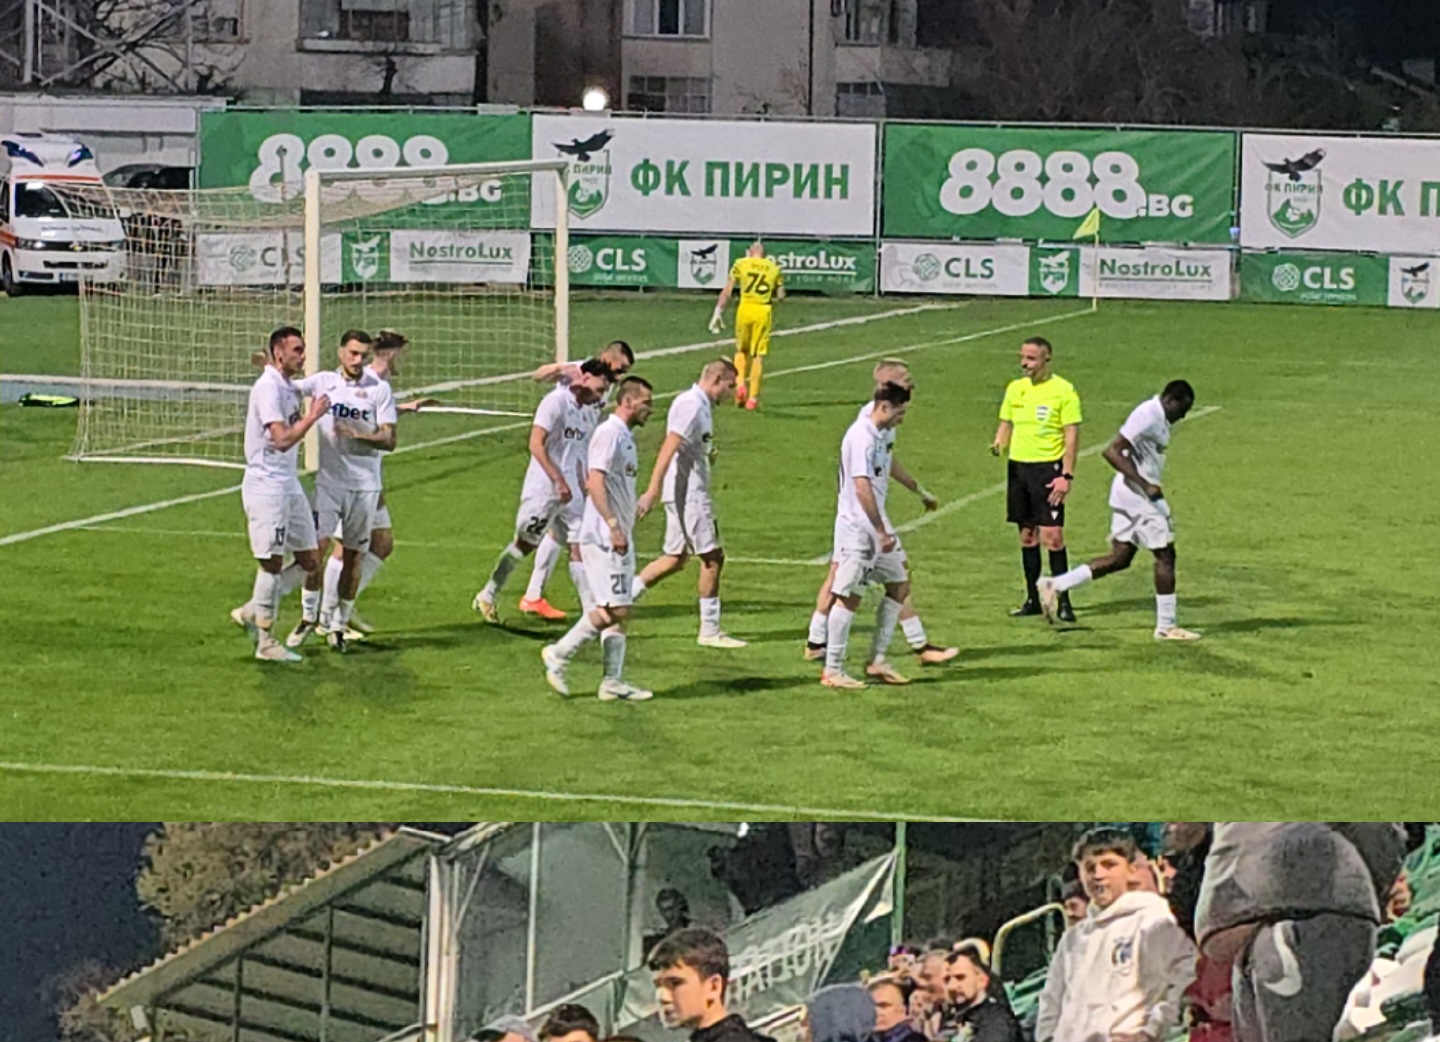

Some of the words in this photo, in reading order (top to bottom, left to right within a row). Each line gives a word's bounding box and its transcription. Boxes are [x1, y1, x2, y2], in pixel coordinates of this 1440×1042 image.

[630, 158, 692, 197] ФК
[704, 161, 850, 200] ПИРИН
[940, 148, 1194, 219] 8888.BG
[1343, 178, 1405, 216] ФК
[409, 241, 513, 261] NostroLux
[595, 248, 647, 272] CLS
[765, 250, 857, 270] ostroLux
[944, 257, 994, 279] CLS
[1099, 258, 1212, 277] NostroLux
[1303, 266, 1356, 290] CLS
[744, 272, 771, 295] 76
[329, 402, 371, 421] fbet
[526, 515, 549, 536] 22
